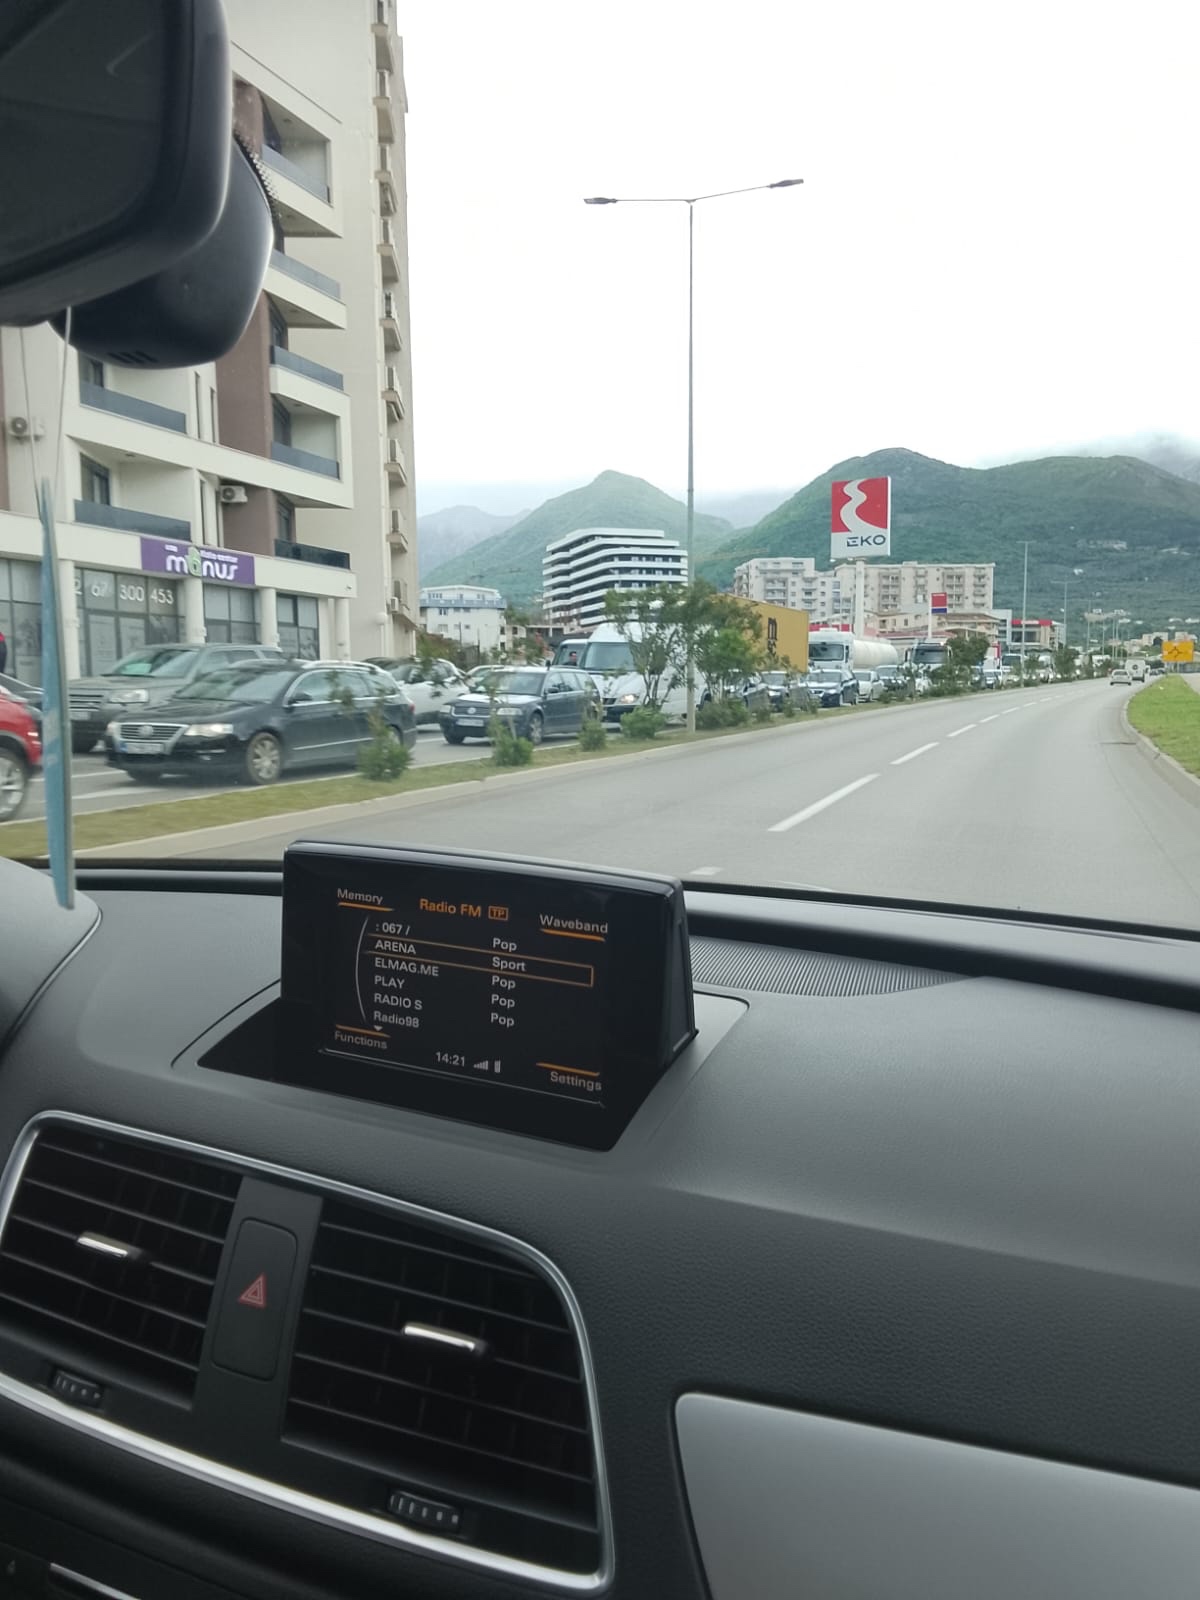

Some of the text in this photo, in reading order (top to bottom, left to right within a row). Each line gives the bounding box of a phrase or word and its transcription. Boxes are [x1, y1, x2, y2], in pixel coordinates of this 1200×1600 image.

[846, 534, 886, 547] EKO
[119, 585, 145, 602] 300
[149, 588, 174, 605] 453
[336, 887, 384, 905] Memory
[419, 898, 482, 918] Radio FM
[382, 921, 402, 935] 067
[539, 913, 608, 934] Waveband
[374, 939, 417, 955] ARENA
[492, 937, 518, 952] Pop
[374, 957, 440, 977] ELMAG.ME
[491, 956, 526, 972] Sport
[374, 975, 406, 990] PLAY
[491, 975, 516, 990] Pop
[373, 992, 423, 1010] RADIO S
[490, 993, 516, 1009] Pop
[373, 1010, 420, 1028] Radio98
[490, 1012, 515, 1028] Pop
[334, 1030, 388, 1049] Functions
[435, 1051, 466, 1067] 14:21
[550, 1071, 602, 1092] Settings
